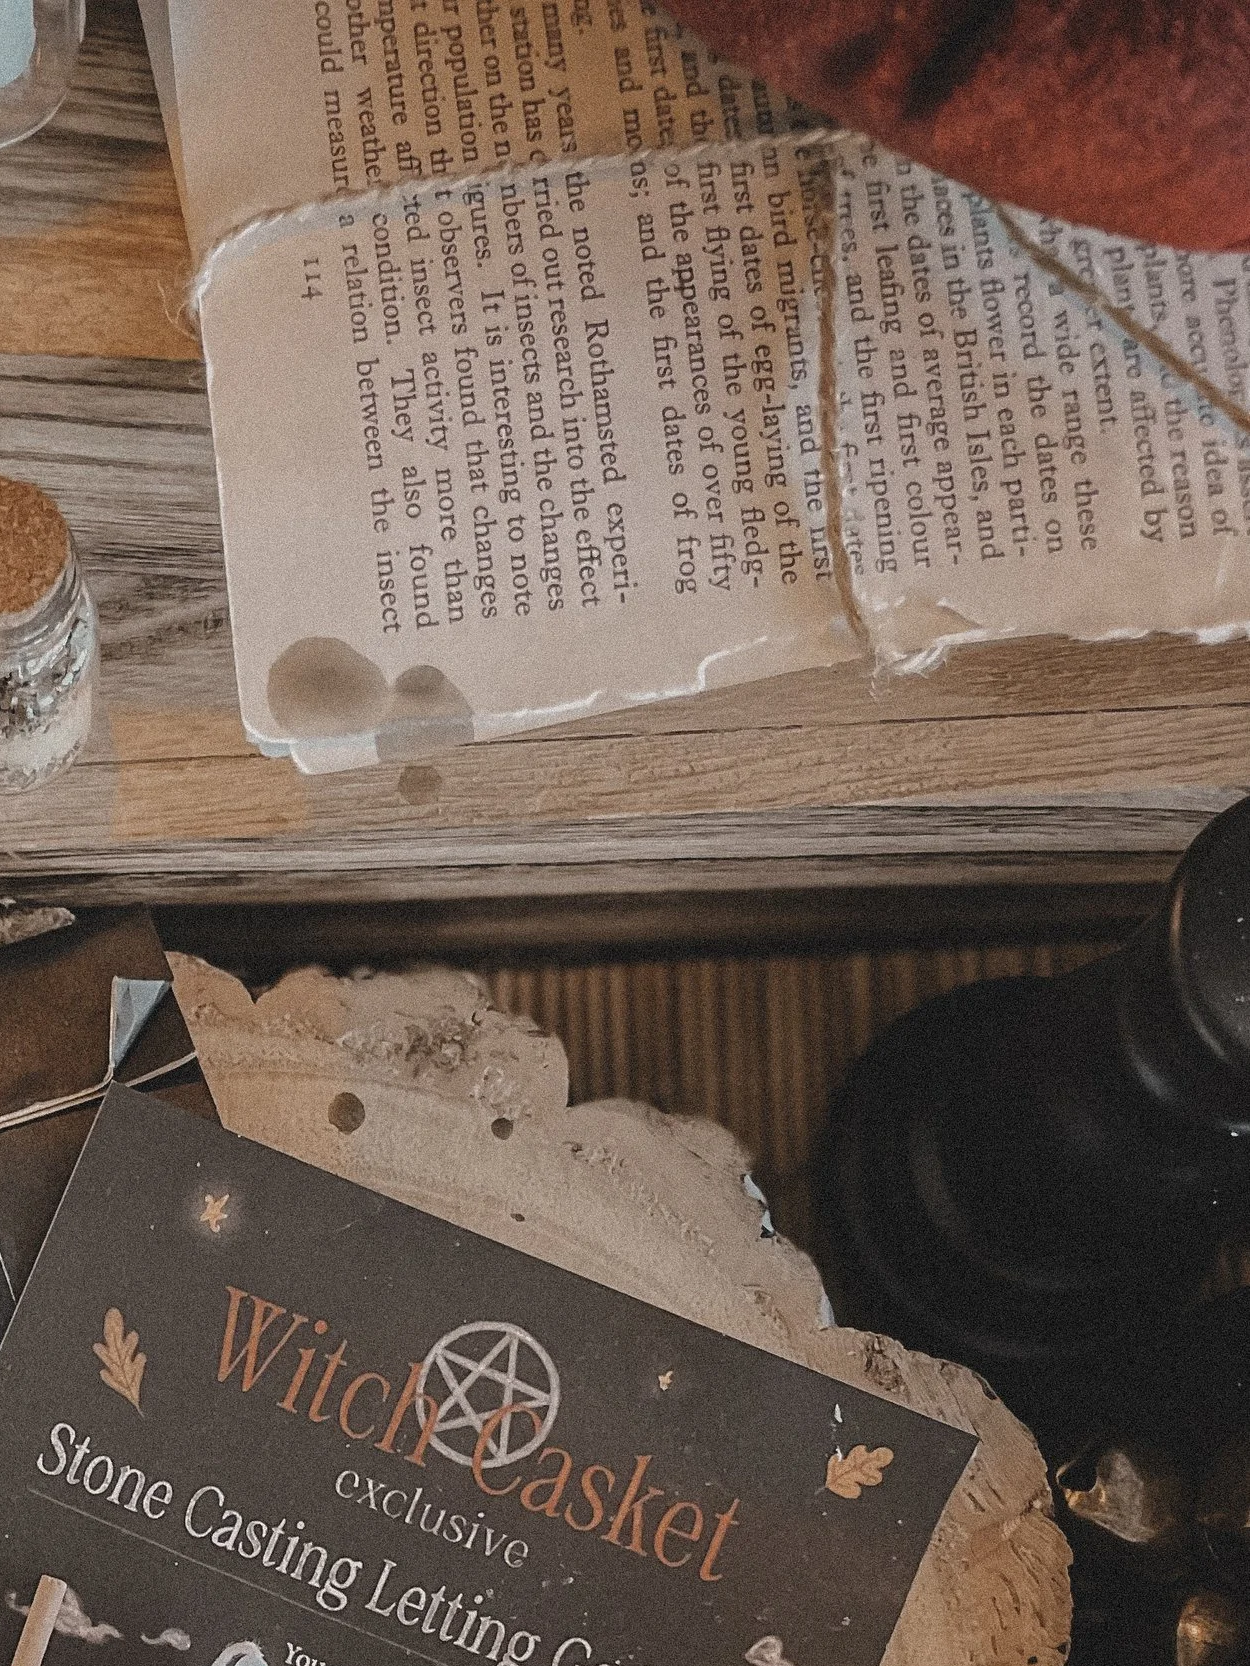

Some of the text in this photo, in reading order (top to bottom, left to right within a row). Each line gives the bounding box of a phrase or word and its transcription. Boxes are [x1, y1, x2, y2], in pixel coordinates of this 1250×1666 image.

[299, 256, 323, 301] 114
[370, 211, 440, 631] condition. They also found
[408, 256, 467, 625] insect activity more than
[436, 209, 498, 619] observers found that changes
[563, 169, 630, 604] the noted Rothamsted experi-
[728, 159, 802, 585] first dates of egg-laying of the
[35, 1421, 173, 1520] Stone
[183, 1484, 363, 1612] Casting
[215, 1284, 741, 1581] Witch Casket
[334, 1468, 529, 1568] exclusive
